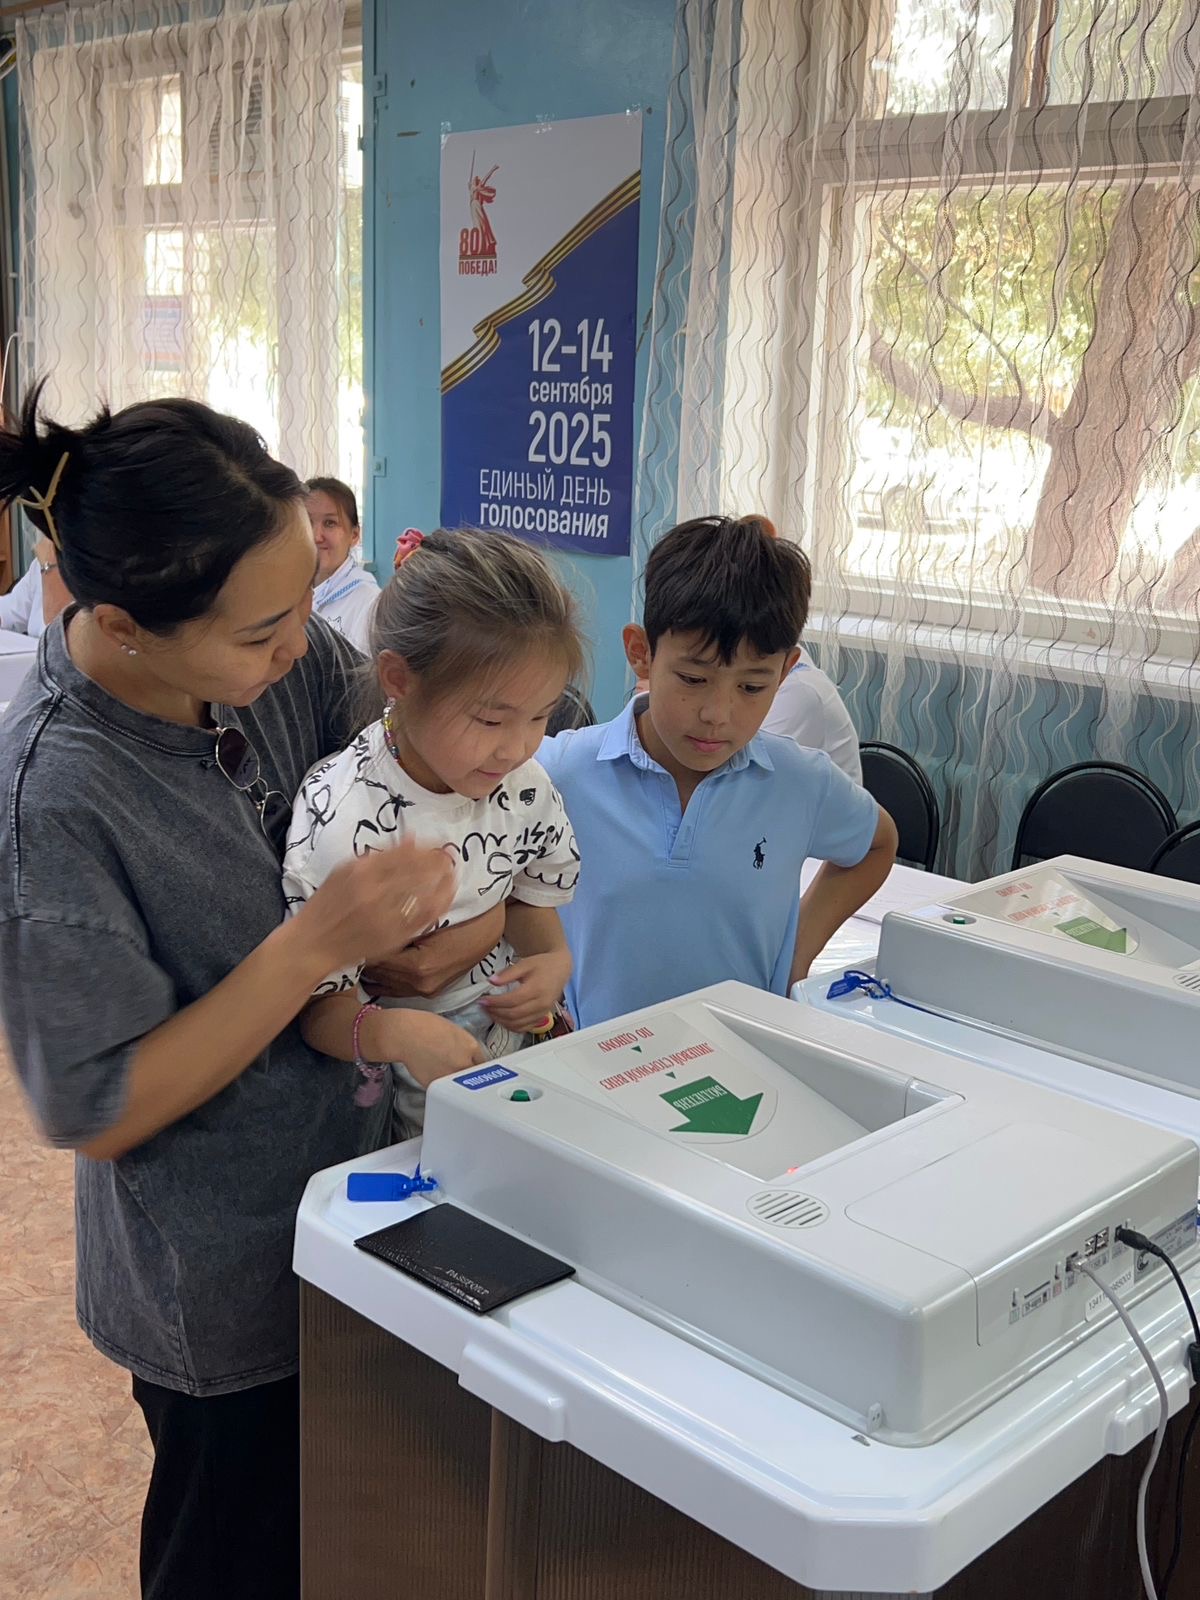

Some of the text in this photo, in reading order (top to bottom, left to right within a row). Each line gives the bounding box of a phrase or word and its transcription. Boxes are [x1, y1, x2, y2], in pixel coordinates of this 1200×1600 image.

[459, 227, 482, 256] 80
[458, 259, 498, 277] ПОБЕДА!
[528, 318, 613, 373] 12-14
[529, 376, 612, 410] сентября
[528, 410, 612, 467] 2025
[479, 468, 611, 507] ЕДИНЫЙ ДЕНЬ
[480, 503, 609, 538] голосования
[597, 1026, 655, 1053] ПО ОДНОМУ
[599, 1042, 715, 1090] ЛИЦЕВОЙ СТОРОНОЙ ВНИЗ
[672, 1084, 728, 1111] БЮЛЛЕТЕНЬ
